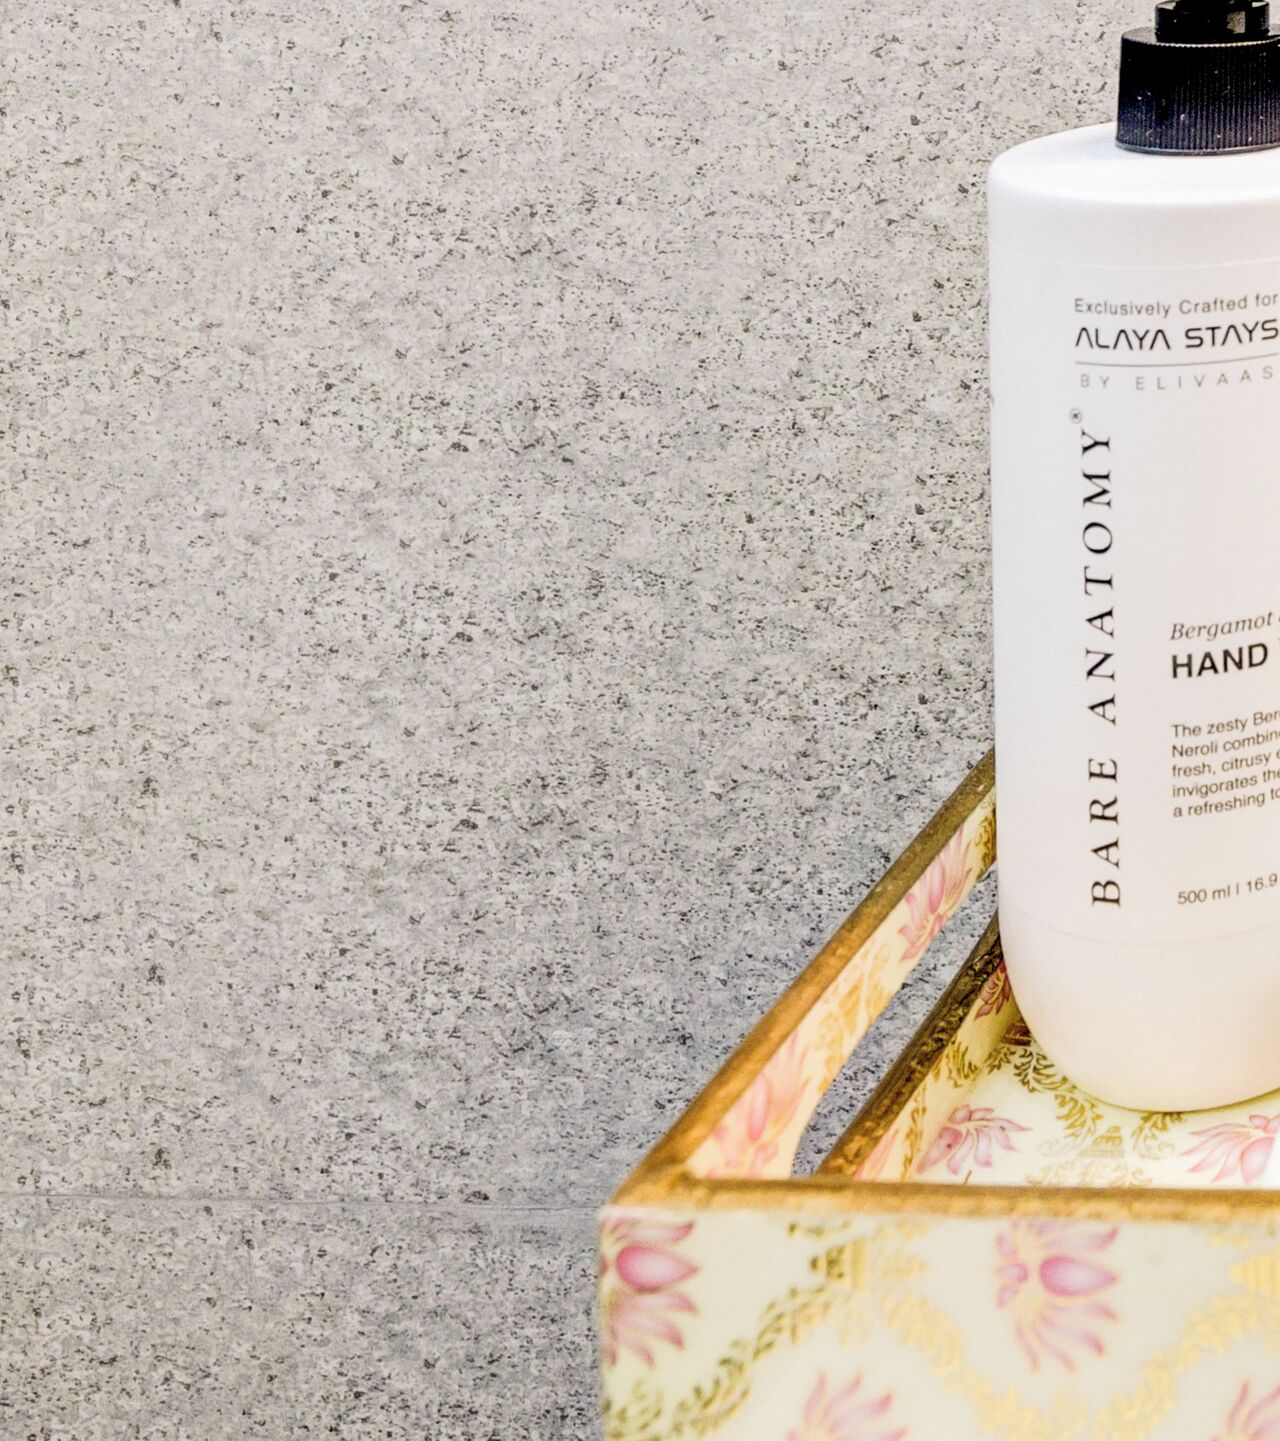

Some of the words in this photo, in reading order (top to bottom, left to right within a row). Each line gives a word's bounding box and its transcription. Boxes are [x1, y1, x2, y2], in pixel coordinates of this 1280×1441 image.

[1074, 298, 1171, 319] Exclusively
[1179, 296, 1248, 314] Crafted
[1255, 293, 1279, 308] for
[1075, 327, 1171, 351] ALAYA
[1185, 318, 1280, 349] STAYS
[1081, 374, 1110, 388] BY
[1135, 366, 1274, 391] ELIVAAS
[1169, 611, 1274, 641] Bergamot
[1172, 643, 1268, 679] HAND
[1172, 724, 1201, 738] The
[1207, 717, 1248, 734] zesty
[1172, 740, 1218, 758] Neroli
[1172, 762, 1217, 778] fresh,
[1221, 751, 1271, 773] citrusy
[1172, 774, 1258, 799] invigorates
[1173, 806, 1183, 818] a
[1188, 792, 1265, 817] refreshing
[1088, 758, 1121, 908] BARE
[1177, 889, 1208, 905] 500
[1212, 884, 1231, 900] ml
[1246, 873, 1279, 894] 16.9
